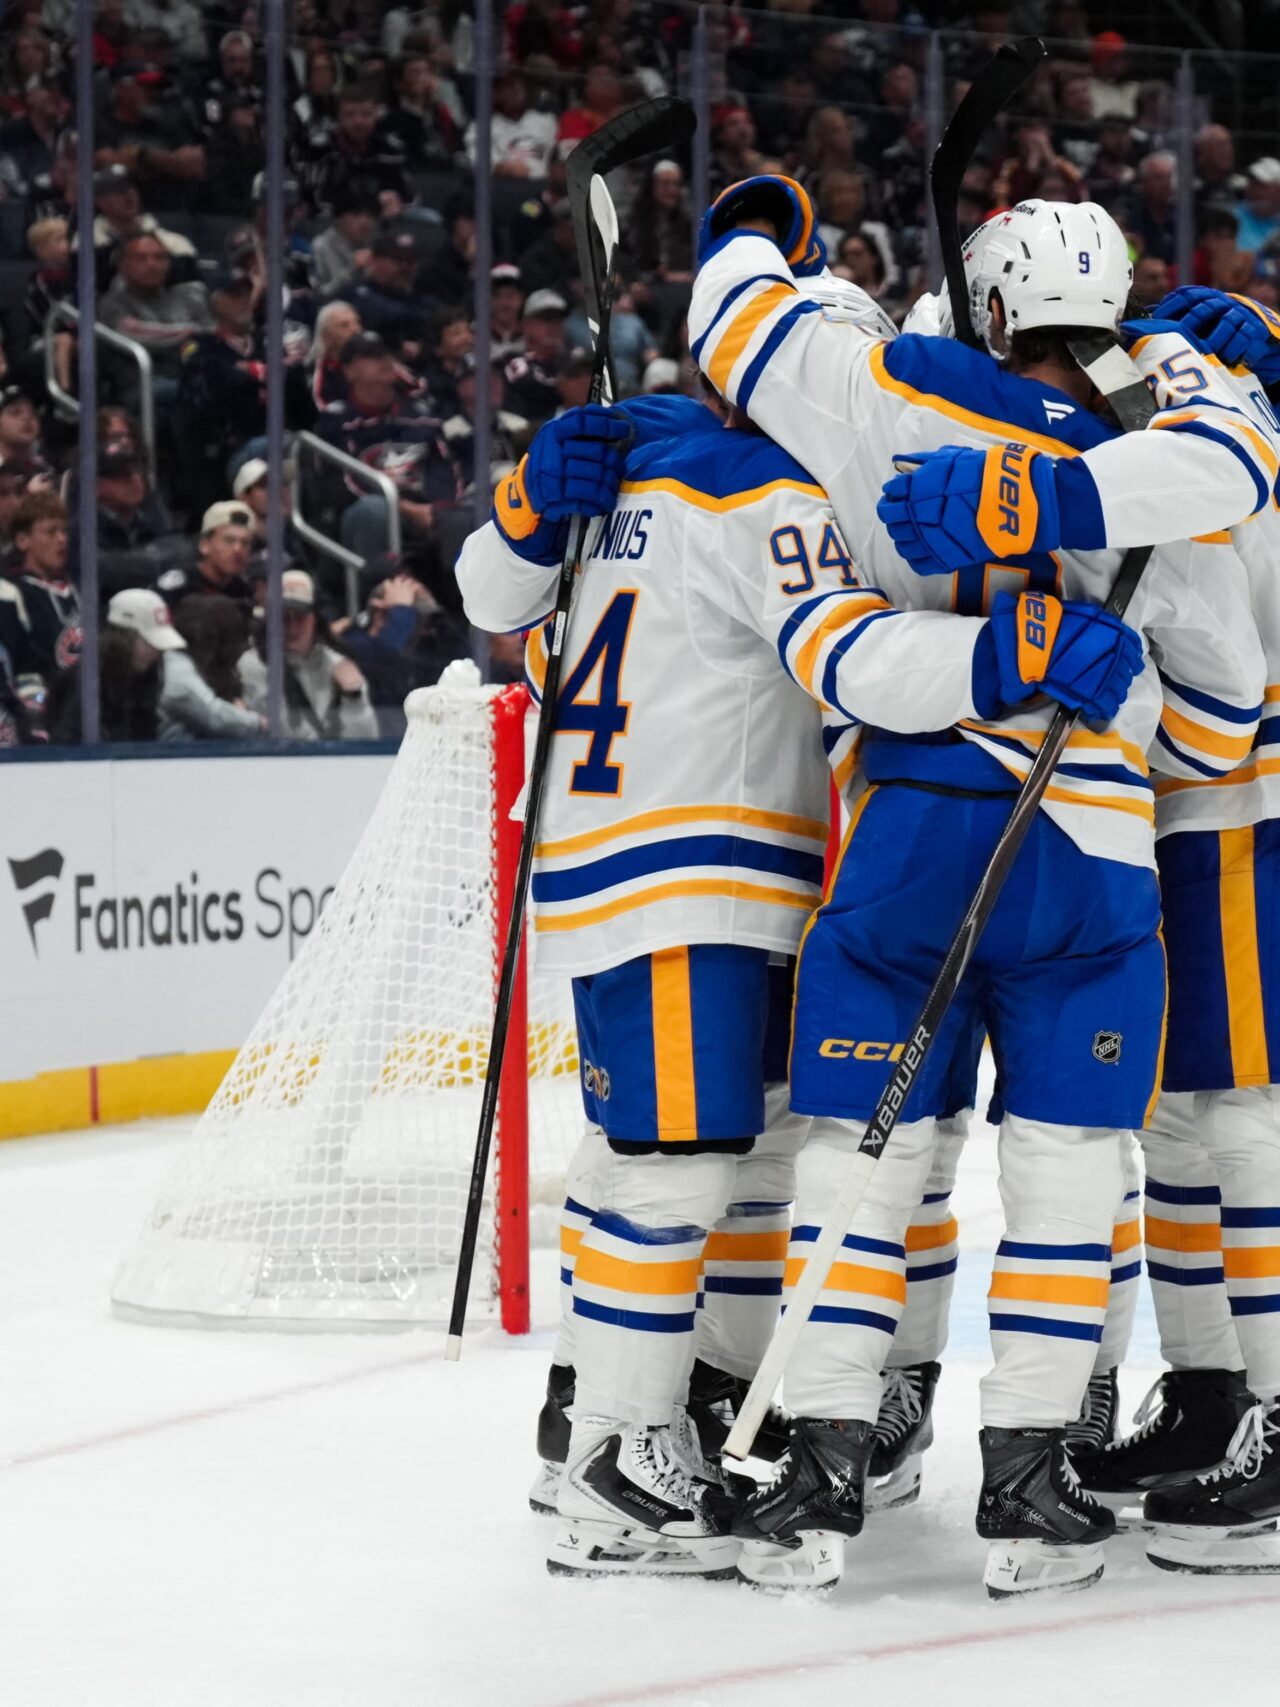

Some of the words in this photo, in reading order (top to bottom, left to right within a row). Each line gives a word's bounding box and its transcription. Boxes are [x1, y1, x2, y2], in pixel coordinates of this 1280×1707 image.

[1078, 251, 1091, 275] 9
[587, 509, 653, 561] NIUS
[768, 521, 863, 597] 94
[74, 870, 244, 953] Fanatics
